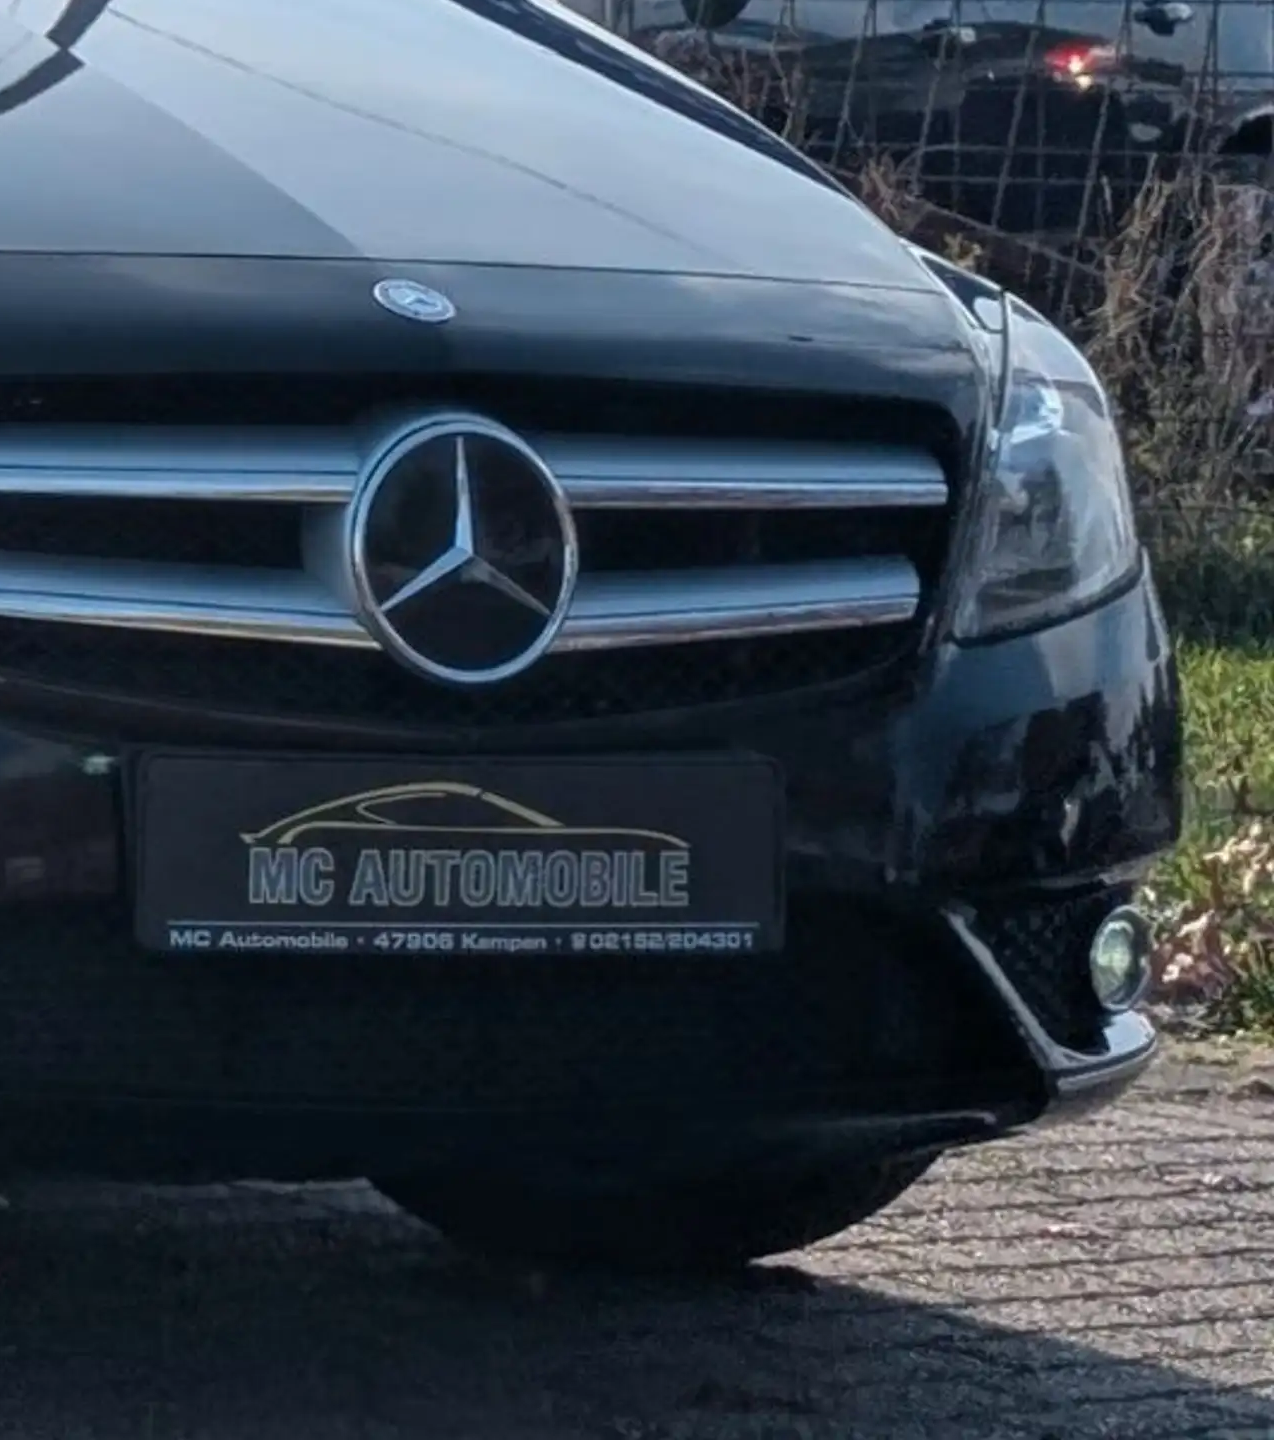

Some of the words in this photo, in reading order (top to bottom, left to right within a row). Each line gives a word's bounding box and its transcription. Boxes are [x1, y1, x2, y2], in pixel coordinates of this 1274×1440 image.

[248, 847, 335, 905] MC
[348, 848, 690, 907] AUTOMOBILE
[169, 929, 211, 948] MC
[219, 930, 348, 950] Automobile
